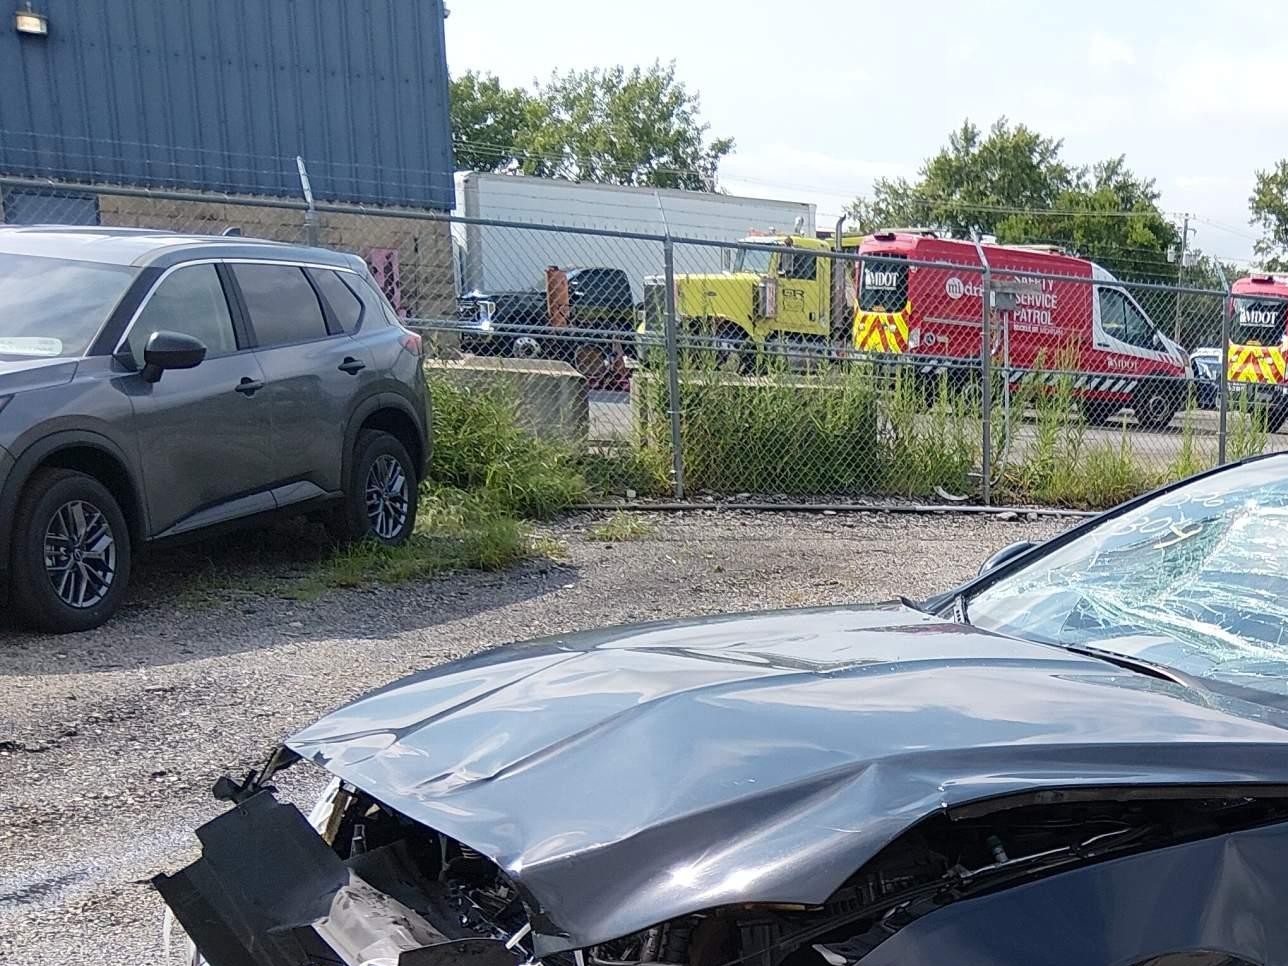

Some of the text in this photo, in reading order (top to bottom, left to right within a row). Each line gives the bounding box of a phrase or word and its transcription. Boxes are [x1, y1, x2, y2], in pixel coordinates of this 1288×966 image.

[867, 271, 899, 287] MDOT
[1015, 291, 1058, 310] SERVICE
[1013, 309, 1054, 326] PATROL
[1243, 310, 1279, 325] MDOT
